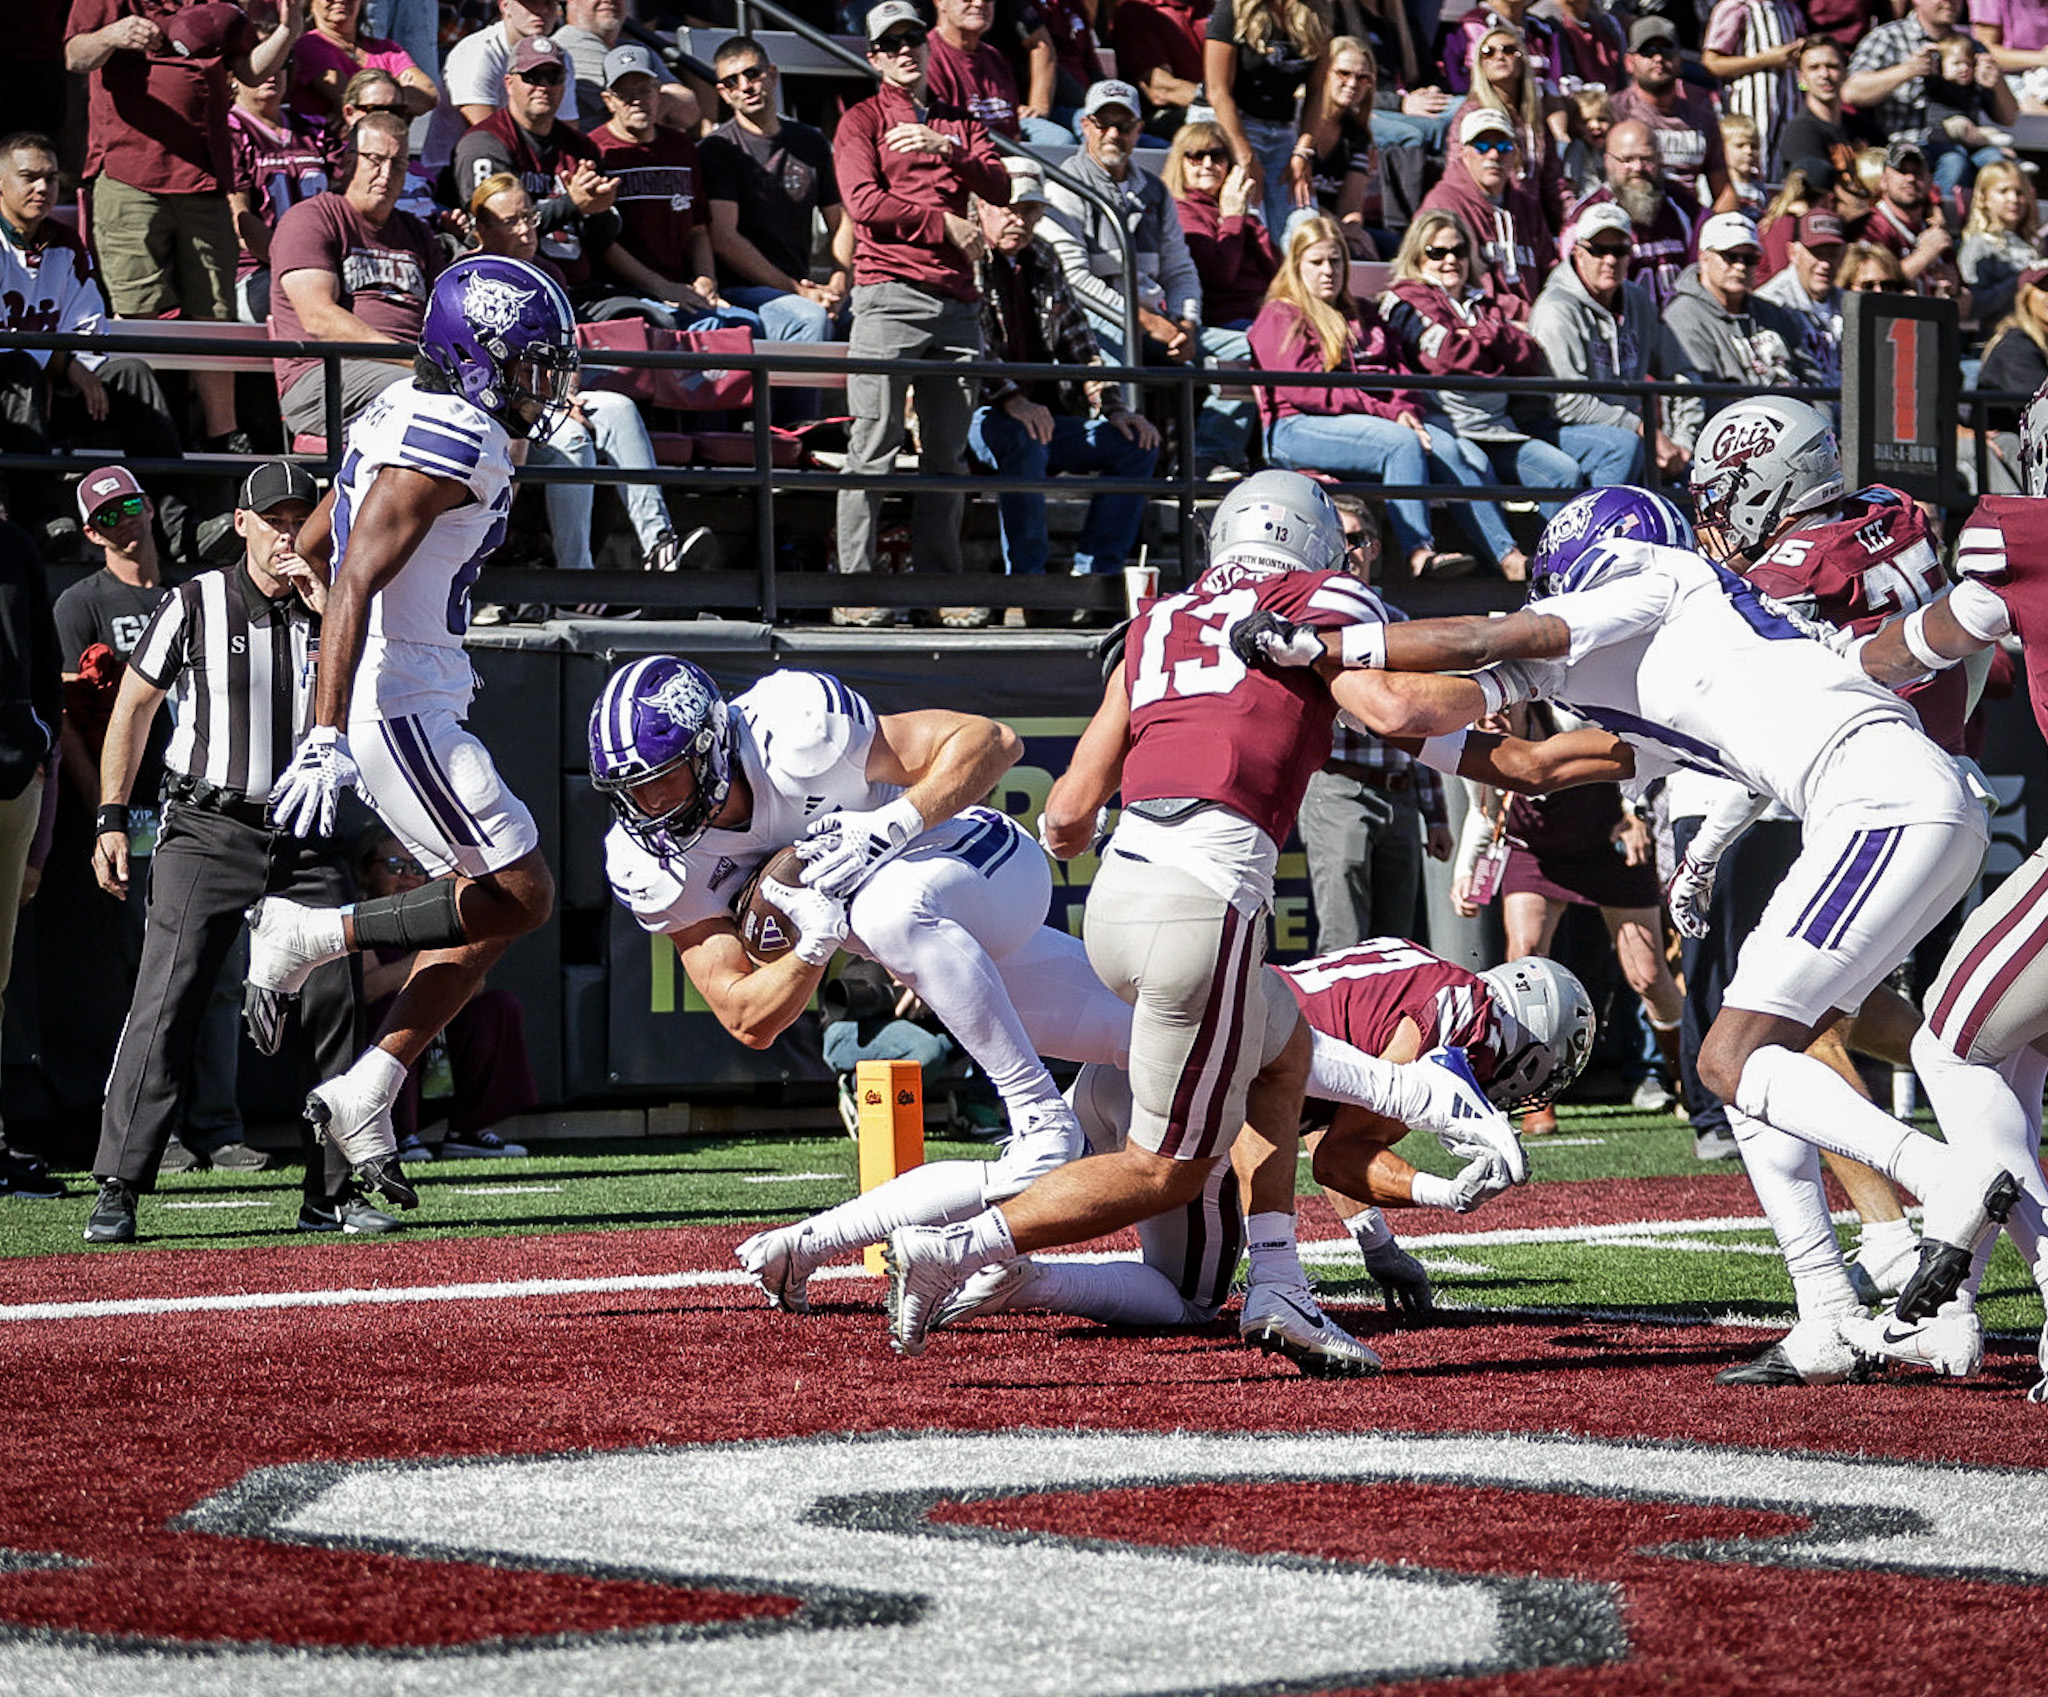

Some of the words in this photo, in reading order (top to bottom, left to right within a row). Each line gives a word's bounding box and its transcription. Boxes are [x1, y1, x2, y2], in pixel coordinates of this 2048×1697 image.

[1886, 317, 1918, 443] 1
[1712, 422, 1776, 462] Griz
[1275, 526, 1289, 542] 13
[1854, 519, 1897, 556] LEE
[1237, 555, 1258, 565] WITH
[231, 635, 247, 654] S
[1129, 587, 1259, 711] 13
[129, 809, 153, 820] VIP
